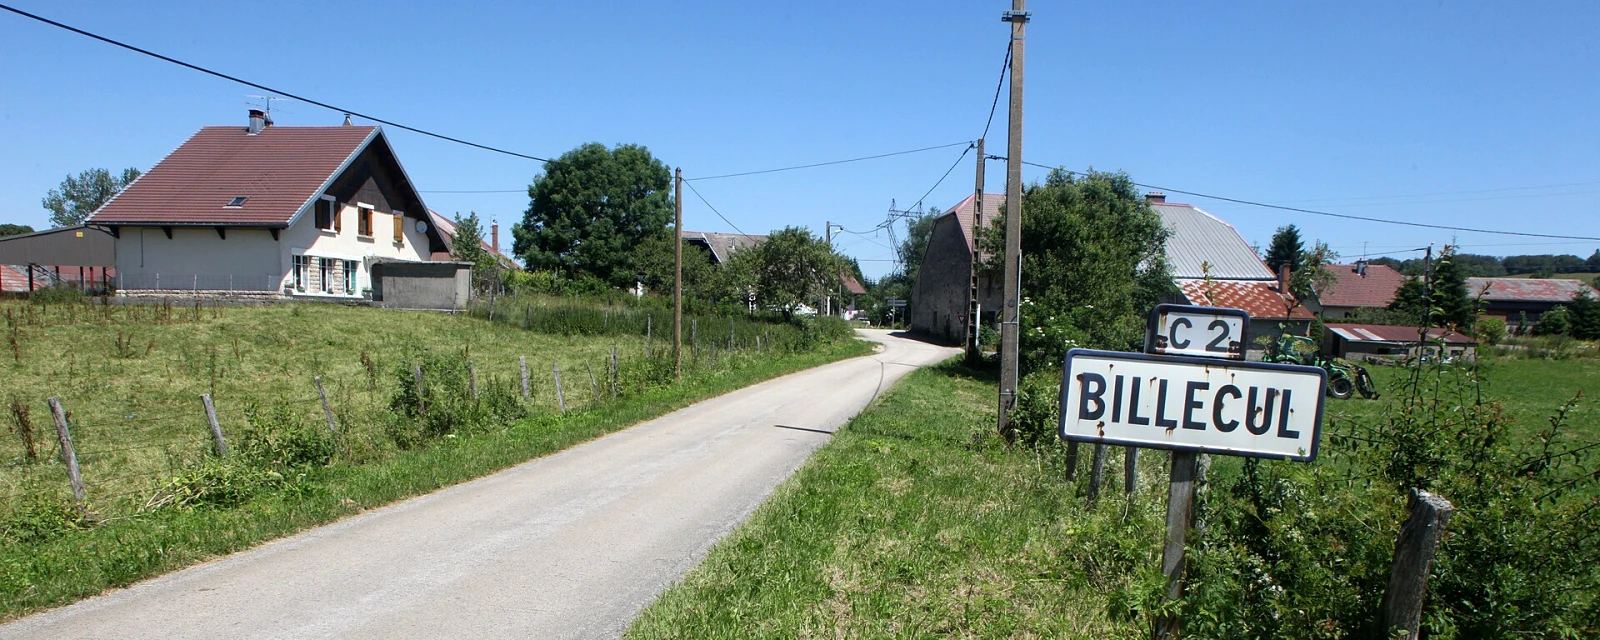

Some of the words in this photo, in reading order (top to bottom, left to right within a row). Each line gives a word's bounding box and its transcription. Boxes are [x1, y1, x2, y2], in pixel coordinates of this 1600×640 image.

[1169, 317, 1192, 350] C
[1205, 319, 1230, 351] 2
[1078, 372, 1300, 439] BILLECUL
